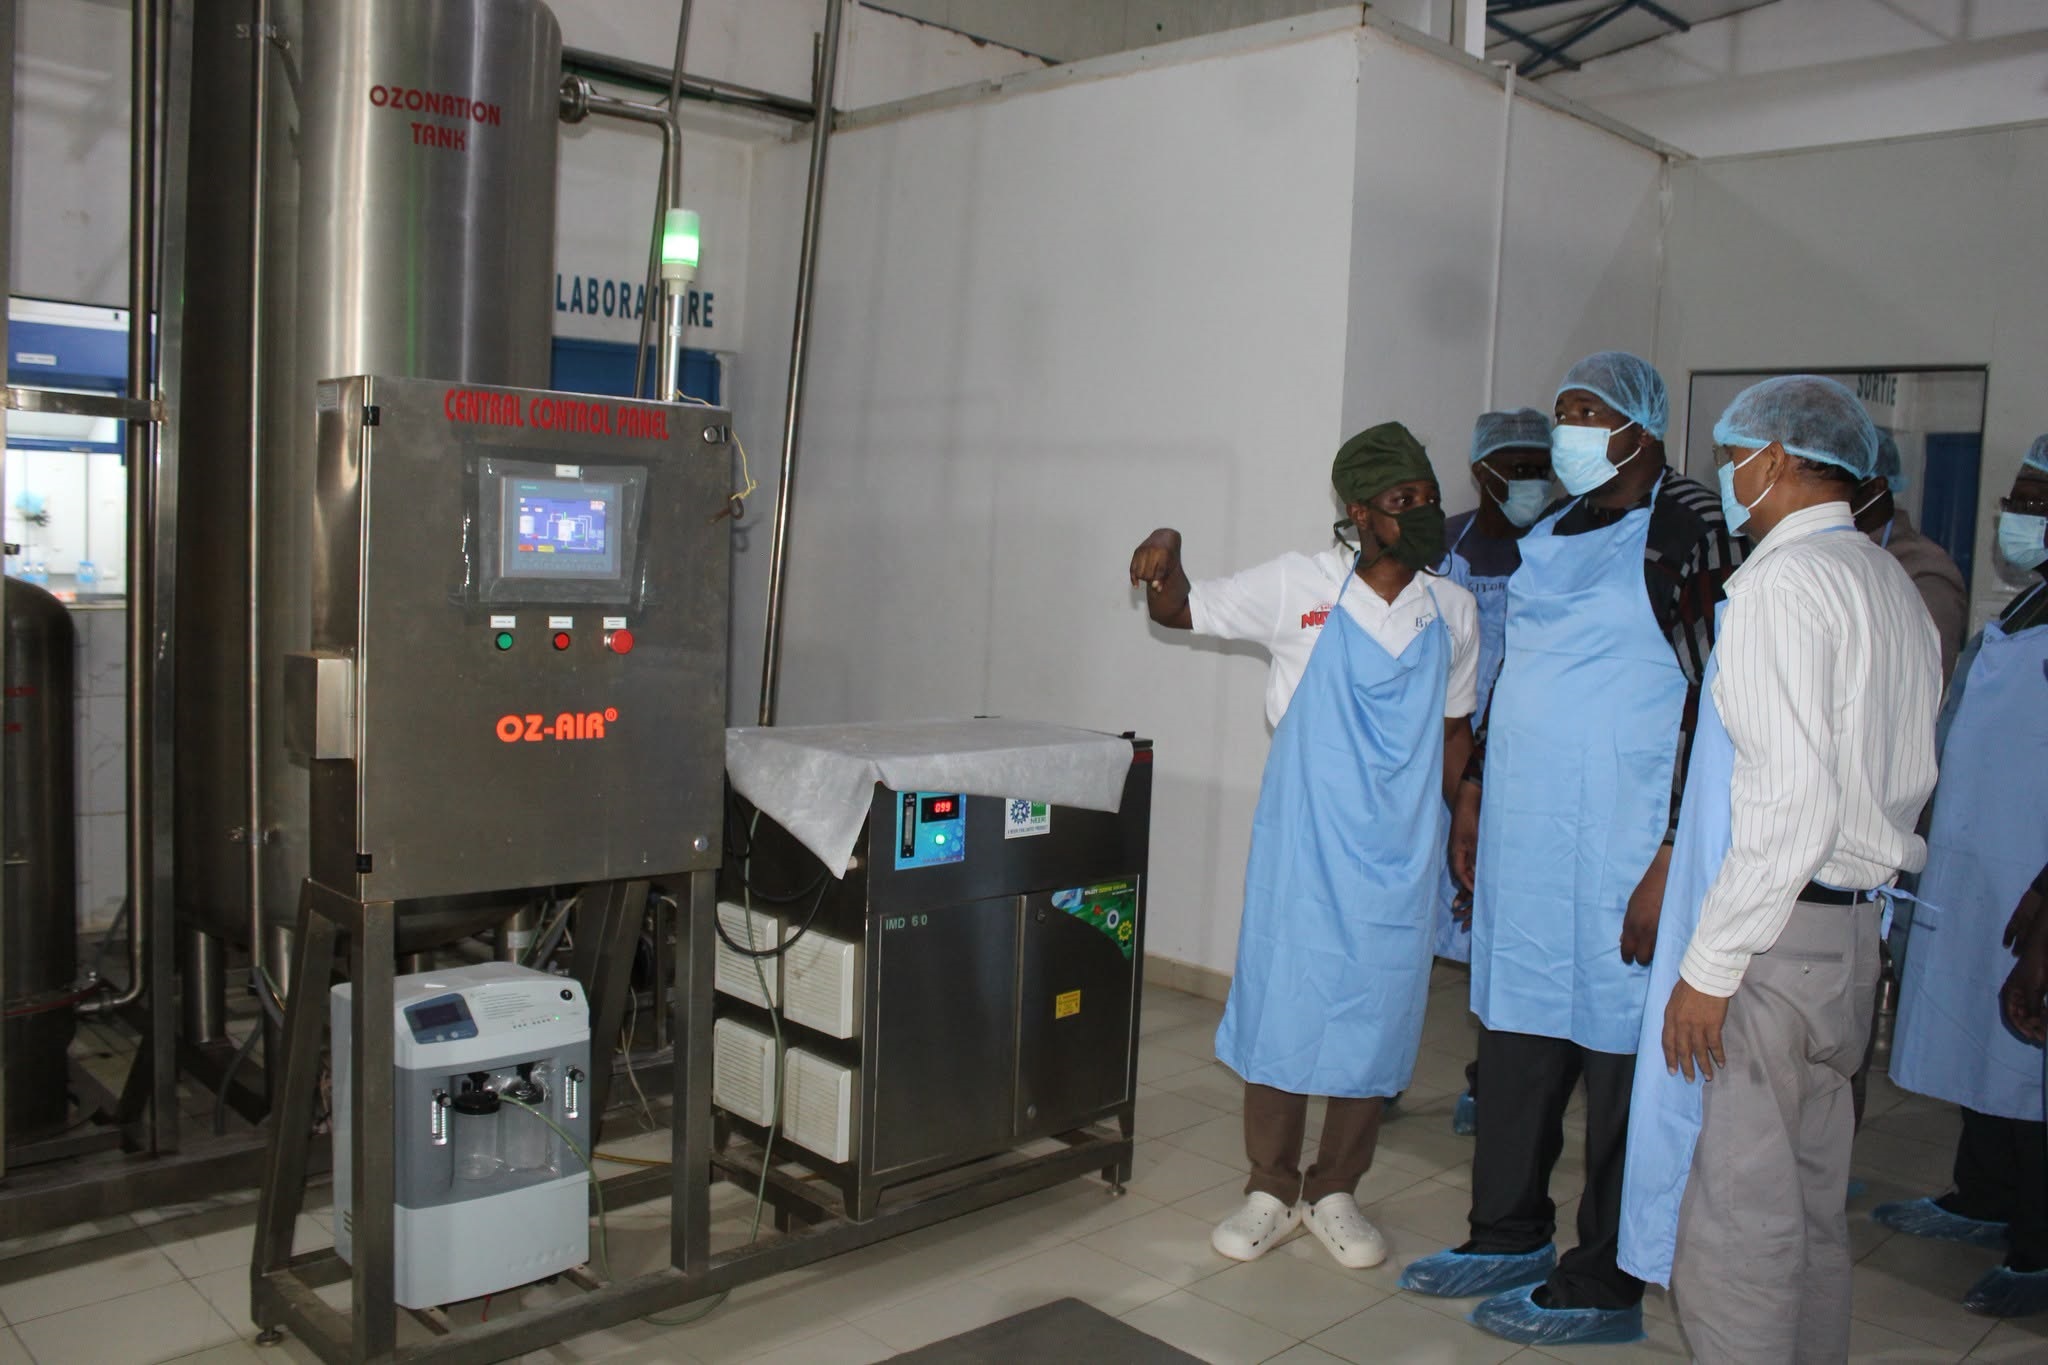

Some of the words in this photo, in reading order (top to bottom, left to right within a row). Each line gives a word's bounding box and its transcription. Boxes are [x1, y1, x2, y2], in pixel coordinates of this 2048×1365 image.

[370, 85, 500, 127] OZONATION
[411, 121, 465, 152] TANK
[556, 273, 714, 328] LABORATRE
[443, 389, 524, 427] CENTRAL
[529, 397, 612, 435] CONTROL
[616, 406, 669, 440] PANEL
[885, 917, 906, 930] IMD
